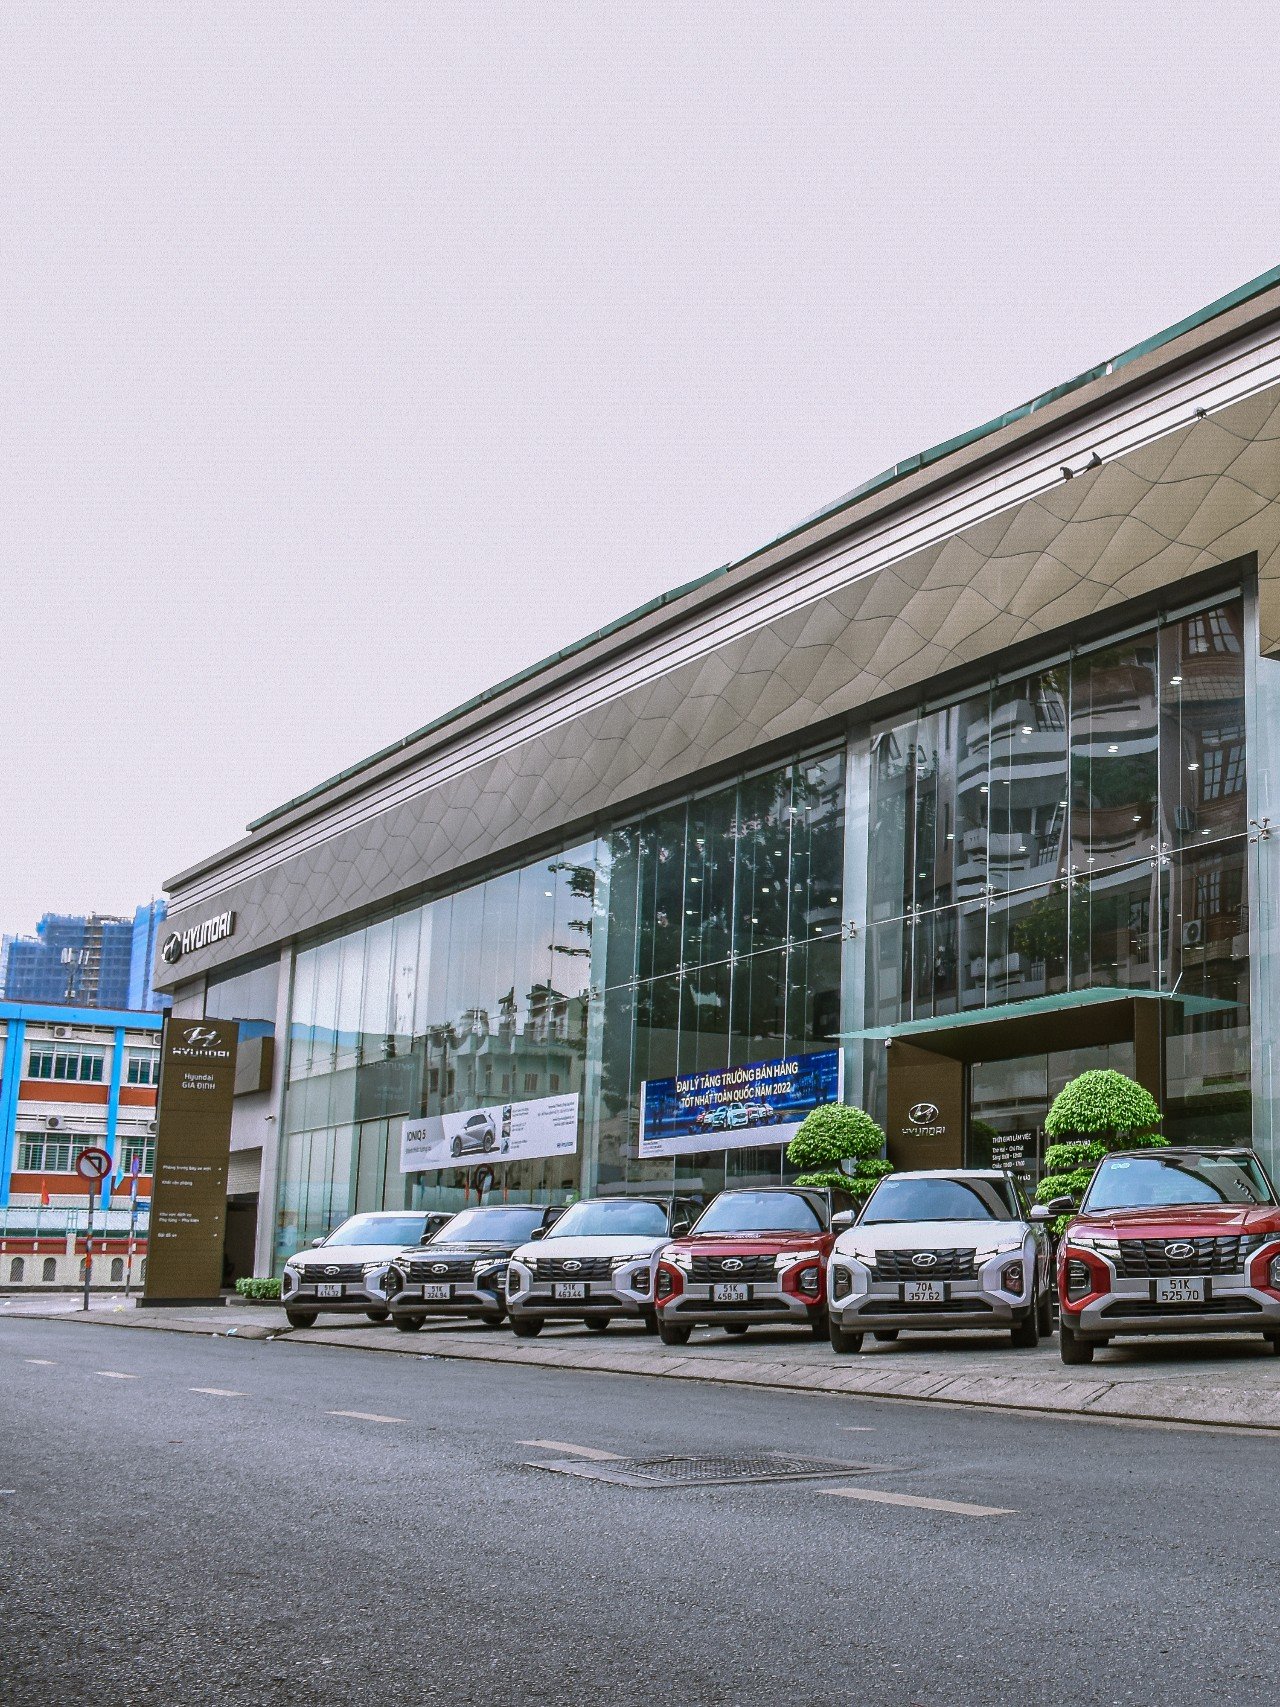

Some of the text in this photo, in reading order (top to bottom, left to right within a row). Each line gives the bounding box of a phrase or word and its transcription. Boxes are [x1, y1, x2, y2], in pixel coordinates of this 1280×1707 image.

[182, 910, 233, 954] HYUNDAI
[172, 1047, 230, 1058] HYUNDAI
[184, 1073, 214, 1082] Hyundai
[690, 1076, 699, 1091] LÝ
[700, 1074, 721, 1089] TĂNG
[722, 1068, 755, 1086] TRƯỞNG
[756, 1064, 773, 1080] BÁN
[774, 1060, 799, 1077] HÀNG
[694, 1089, 714, 1107] NHẤT
[714, 1089, 733, 1103] TOÀN
[733, 1084, 755, 1101] QUỐC
[755, 1084, 772, 1097] NĂM
[773, 1082, 791, 1095] 2022
[901, 1126, 946, 1137] HYUNDAI
[723, 1284, 738, 1292] 51K
[915, 1282, 933, 1291] 70A
[1170, 1280, 1190, 1290] 51K
[908, 1292, 940, 1301] 357.62
[1161, 1290, 1199, 1300] 525.70
